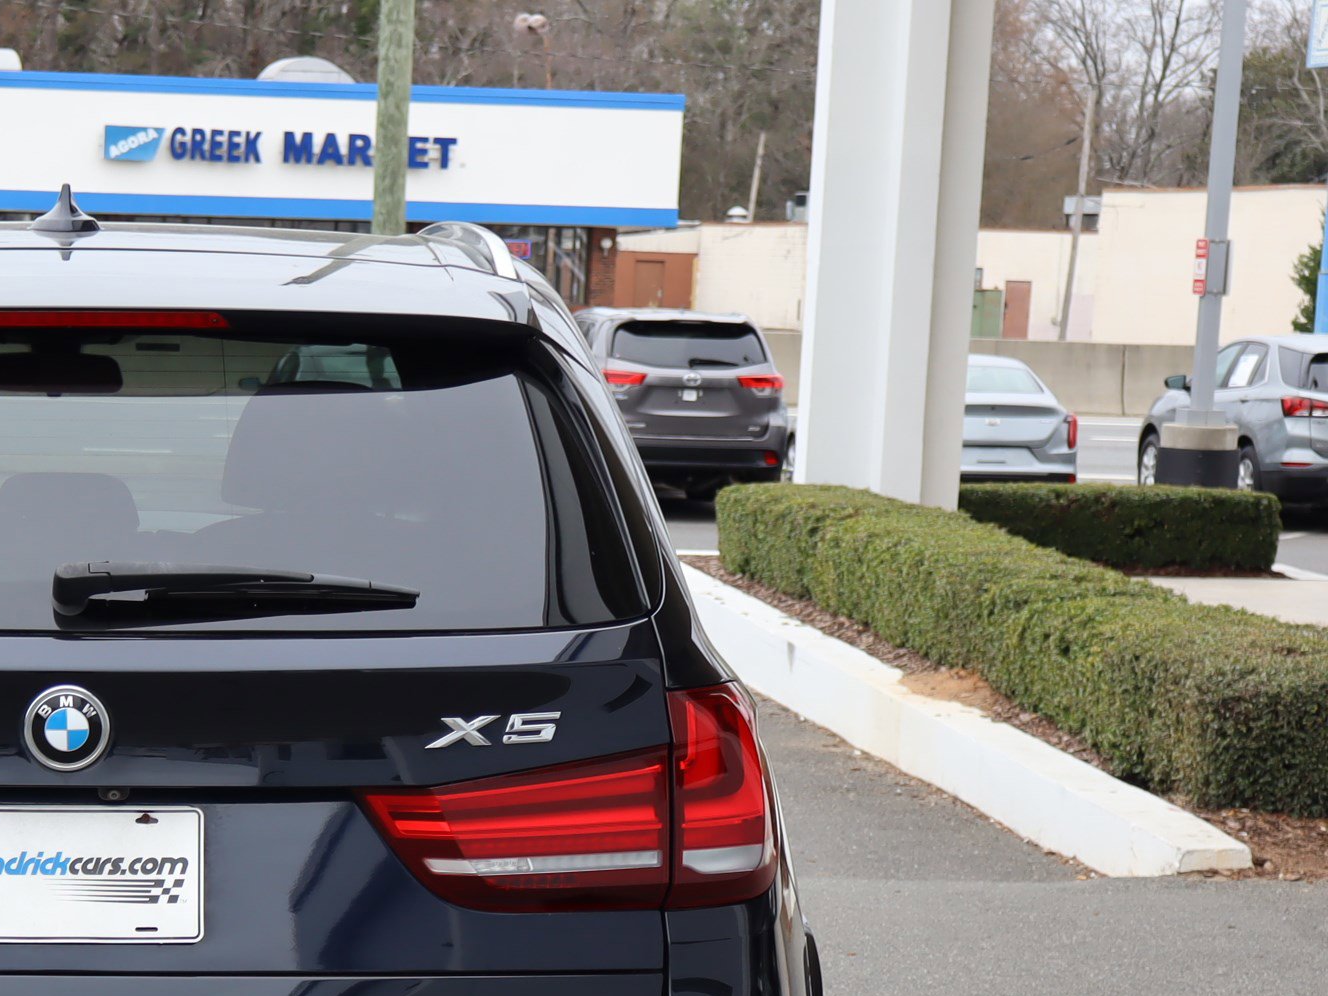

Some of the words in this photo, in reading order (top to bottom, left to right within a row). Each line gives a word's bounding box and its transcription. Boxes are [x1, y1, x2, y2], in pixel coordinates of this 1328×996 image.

[108, 127, 159, 159] AGORA
[171, 127, 263, 164] GREEK
[282, 131, 458, 170] MARET
[37, 695, 97, 719] BMW
[424, 711, 562, 749] X5
